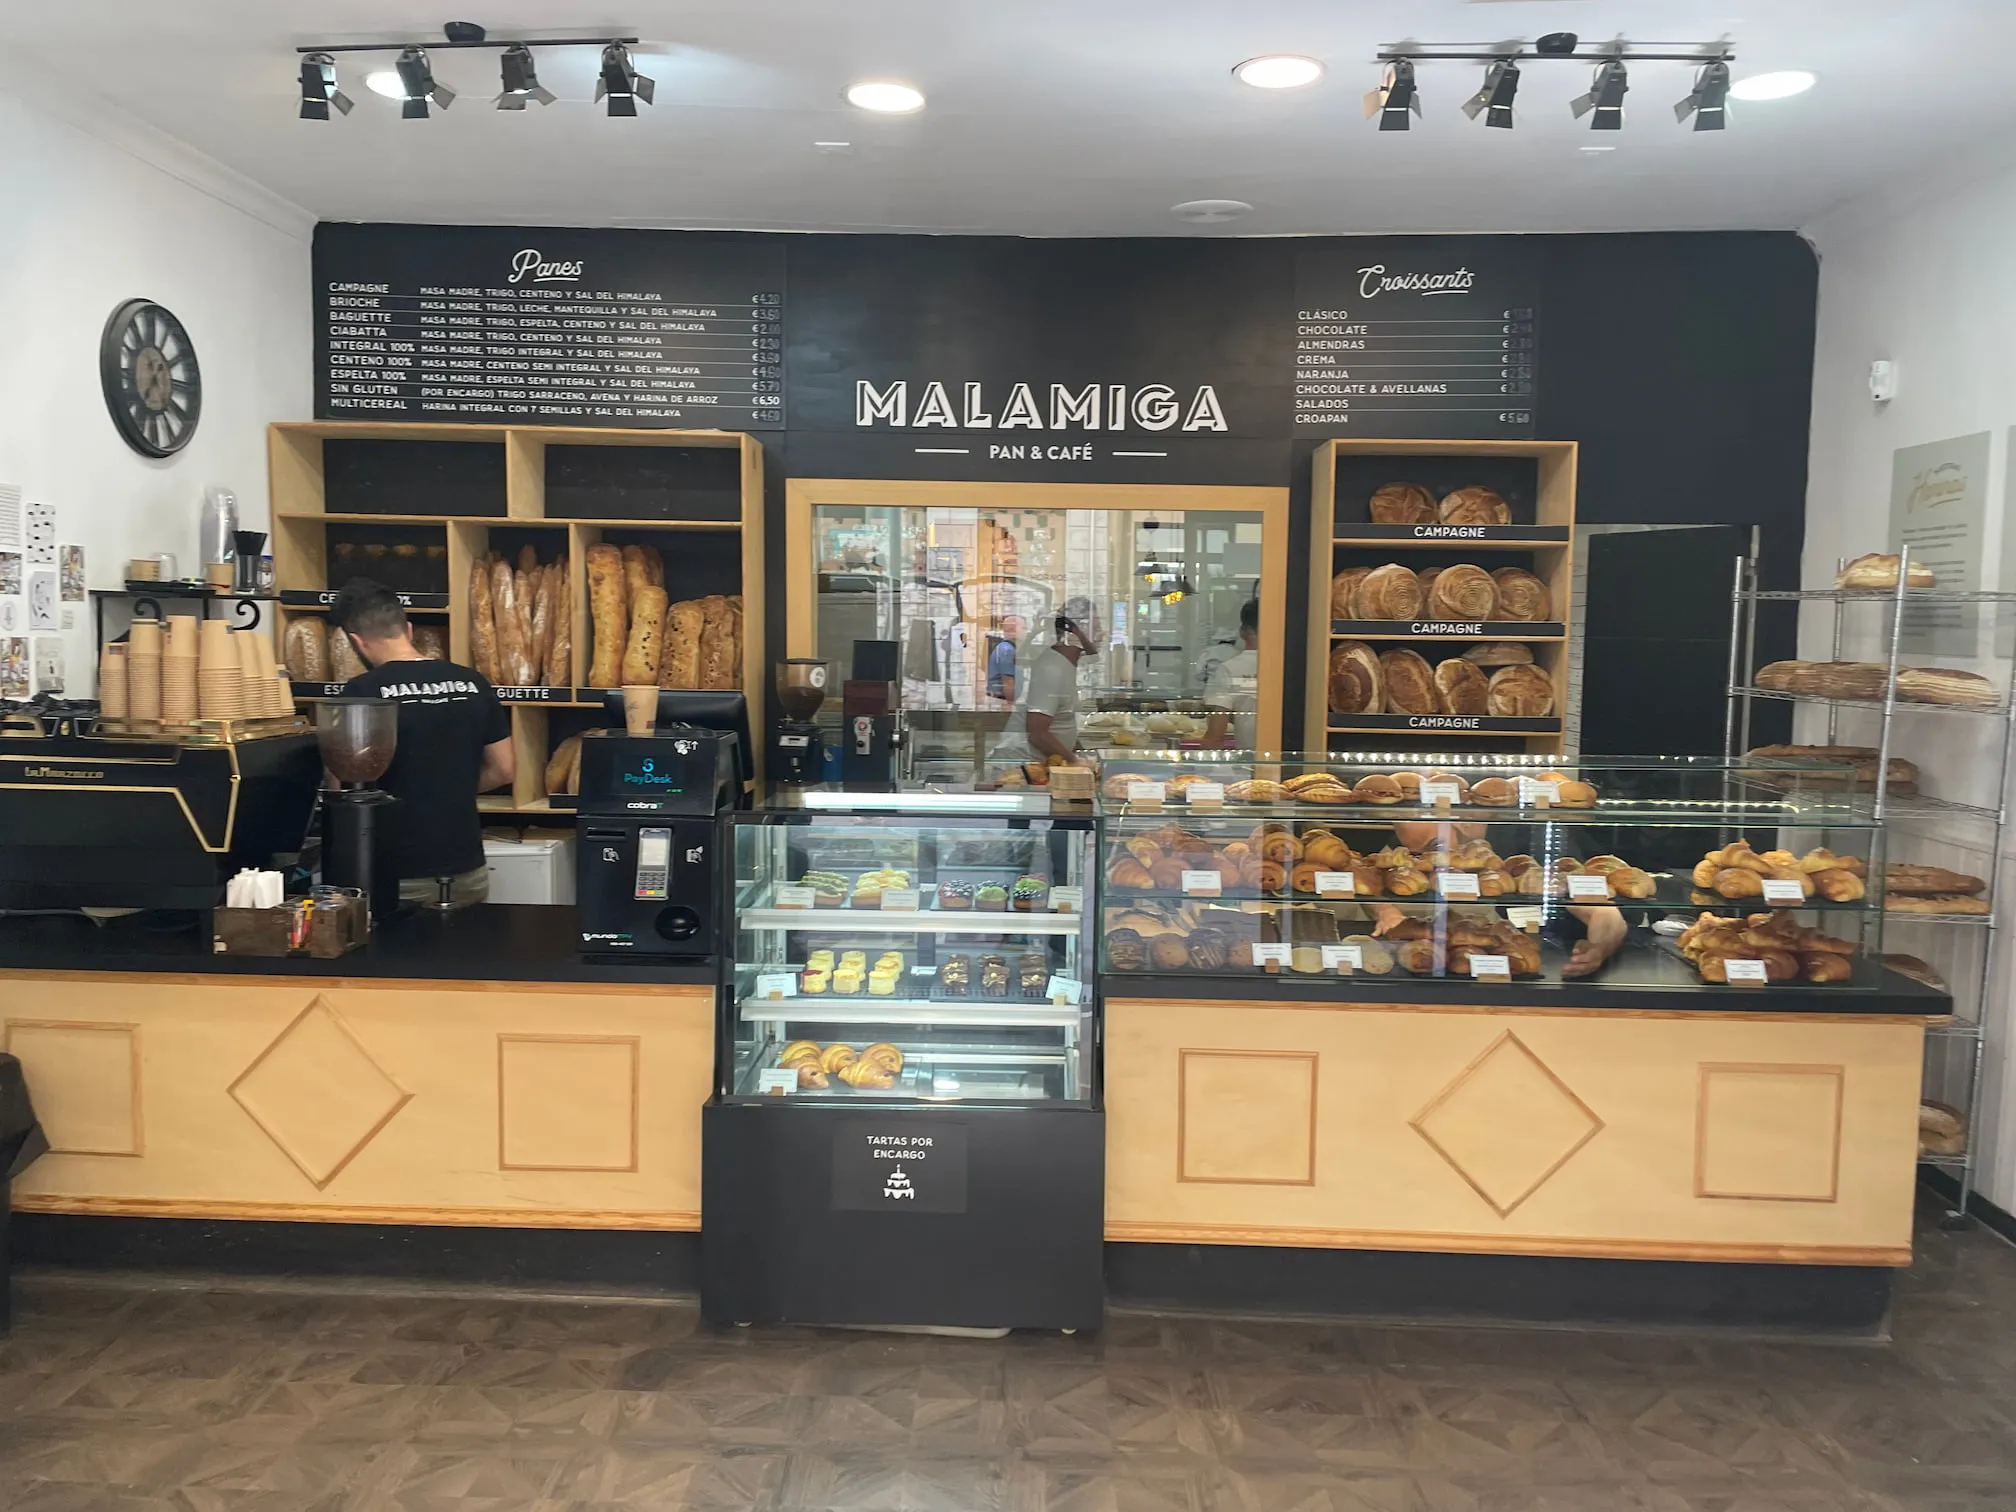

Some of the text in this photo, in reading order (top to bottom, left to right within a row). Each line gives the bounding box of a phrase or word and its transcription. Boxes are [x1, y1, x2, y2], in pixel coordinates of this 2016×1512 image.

[508, 248, 584, 284] Panes
[1357, 264, 1475, 298] Croissants
[329, 282, 388, 293] CAMPAGNE
[420, 287, 445, 295] MASA
[519, 289, 562, 298] CENTENO
[565, 290, 572, 298] Y
[575, 291, 592, 299] SAL
[596, 291, 613, 300] DEL
[616, 292, 661, 301] HIMALAYA
[329, 296, 379, 307] BRIOCHE
[420, 301, 446, 310] MASA
[554, 305, 617, 314] MANTEQUILLA
[620, 306, 627, 314] Y
[630, 307, 648, 315] SAL
[651, 307, 668, 315] DEL
[672, 308, 716, 317] HIMALAYA
[1298, 309, 1348, 320] CLÁSICO
[329, 311, 391, 322] BAGUETTE
[420, 316, 446, 324] MASA
[562, 320, 606, 328] CENTENO
[609, 321, 615, 329] Y
[618, 321, 636, 329] SAL
[639, 322, 657, 330] DEL
[660, 322, 704, 331] HIMALAYA
[330, 325, 386, 336] CIABATTA
[1297, 325, 1368, 335] CHOCOLATE
[421, 330, 446, 339] MASA
[519, 333, 563, 342] CENTENO
[566, 334, 572, 342] Y
[575, 334, 593, 342] SAL
[596, 335, 614, 343] DEL
[617, 336, 662, 344] HIMALAYA
[330, 340, 415, 351] INTEGRAL 100%
[1297, 340, 1365, 350] ALMENDRAS
[420, 345, 446, 353] MASA
[486, 346, 515, 355] TRIGO
[518, 347, 563, 356] INTEGRAL
[576, 349, 594, 357] SAL
[597, 349, 614, 358] DEL
[617, 350, 662, 359] HIMALAYA
[330, 355, 412, 366] CENTENO 100%
[1296, 355, 1336, 365] CREMA
[421, 359, 446, 368] MASA
[485, 361, 529, 370] CENTENO
[532, 362, 553, 370] SEMI
[555, 363, 600, 372] INTEGRAL
[604, 364, 610, 372] Y
[614, 364, 631, 372] SAL
[634, 365, 652, 373] DEL
[655, 365, 700, 374] HIMALAYA
[330, 369, 406, 380] ESPELTA 100%
[1296, 370, 1349, 379] NARANJA
[421, 374, 447, 382] MASA
[486, 375, 524, 384] ESPELTA
[527, 376, 548, 385] SEMI
[551, 377, 596, 386] INTEGRAL
[600, 378, 606, 386] Y
[609, 379, 626, 387] SAL
[630, 379, 647, 387] DEL
[650, 380, 695, 388] HIMALAYA
[330, 383, 397, 394] SIN GLUTEN
[1296, 384, 1447, 394] CHOCOLATE & AVELLANAS
[421, 388, 443, 396] (POR
[446, 388, 494, 397] ENCARGO)
[497, 390, 526, 398] TRIGO
[590, 392, 620, 401] AVENA
[623, 393, 630, 401] Y
[633, 393, 667, 402] HARINA
[670, 394, 683, 402] DE
[686, 395, 718, 403] ARROZ
[330, 398, 406, 408] MULTICEREAL
[856, 380, 1229, 433] MALAMIGA
[1295, 399, 1349, 409] SALADOS
[422, 402, 456, 411] HARINA
[459, 403, 504, 412] INTEGRAL
[508, 404, 528, 413] CON
[530, 405, 536, 413] 7
[539, 405, 582, 414] SEMILLAS
[594, 407, 612, 415] SAL
[615, 407, 633, 416] DEL
[636, 408, 680, 417] HIMALAYA
[1295, 414, 1348, 424] CROAPAN
[989, 442, 1093, 460] PAN & CAFÉ
[1413, 526, 1486, 538] CAMPAGNE
[1411, 622, 1482, 634] CAMPAGNE
[380, 680, 479, 698] MALAMIGA
[1408, 716, 1480, 728] CAMPAGNE
[623, 773, 673, 785] PayDesk
[866, 1135, 933, 1147] TARTAS POR
[873, 1149, 926, 1160] ENCARGO
